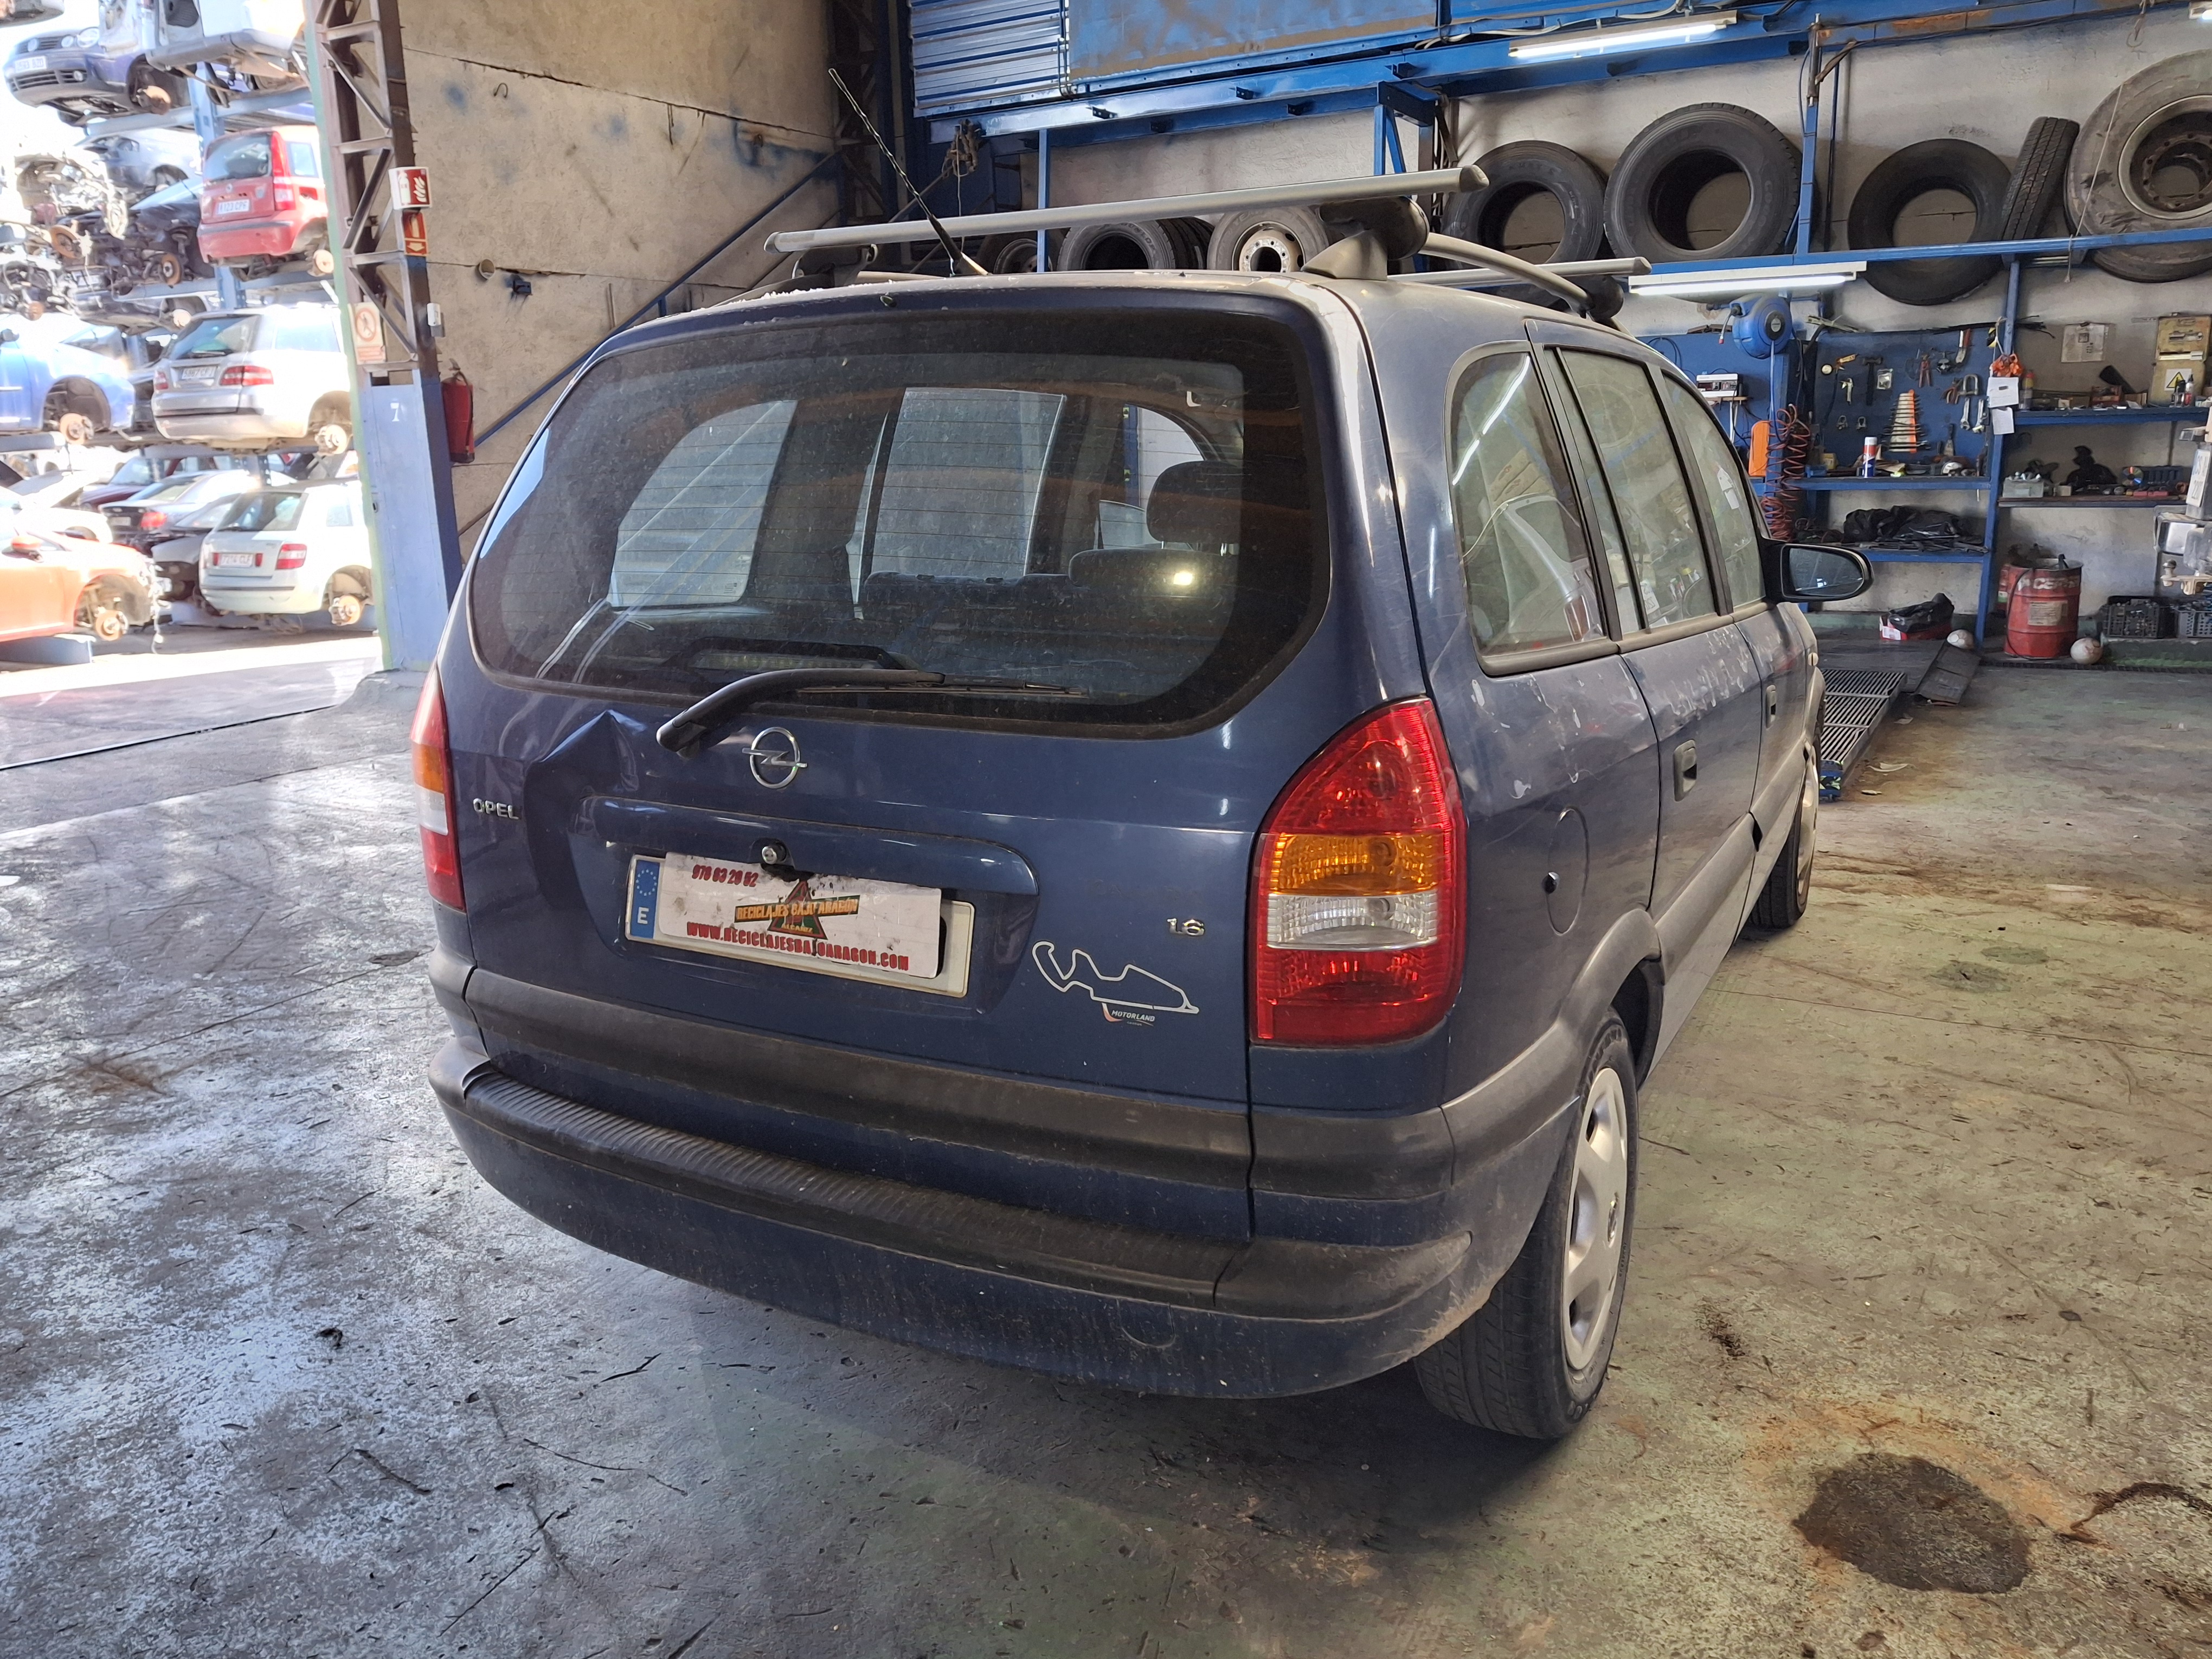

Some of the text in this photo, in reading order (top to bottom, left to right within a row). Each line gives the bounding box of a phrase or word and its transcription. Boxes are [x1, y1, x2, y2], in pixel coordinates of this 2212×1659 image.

[390, 402, 400, 422] 7
[473, 798, 519, 820] OPEL
[638, 906, 650, 924] E
[736, 904, 789, 920] RECICLAJES
[1111, 1009, 1155, 1022] MOTORLAND
